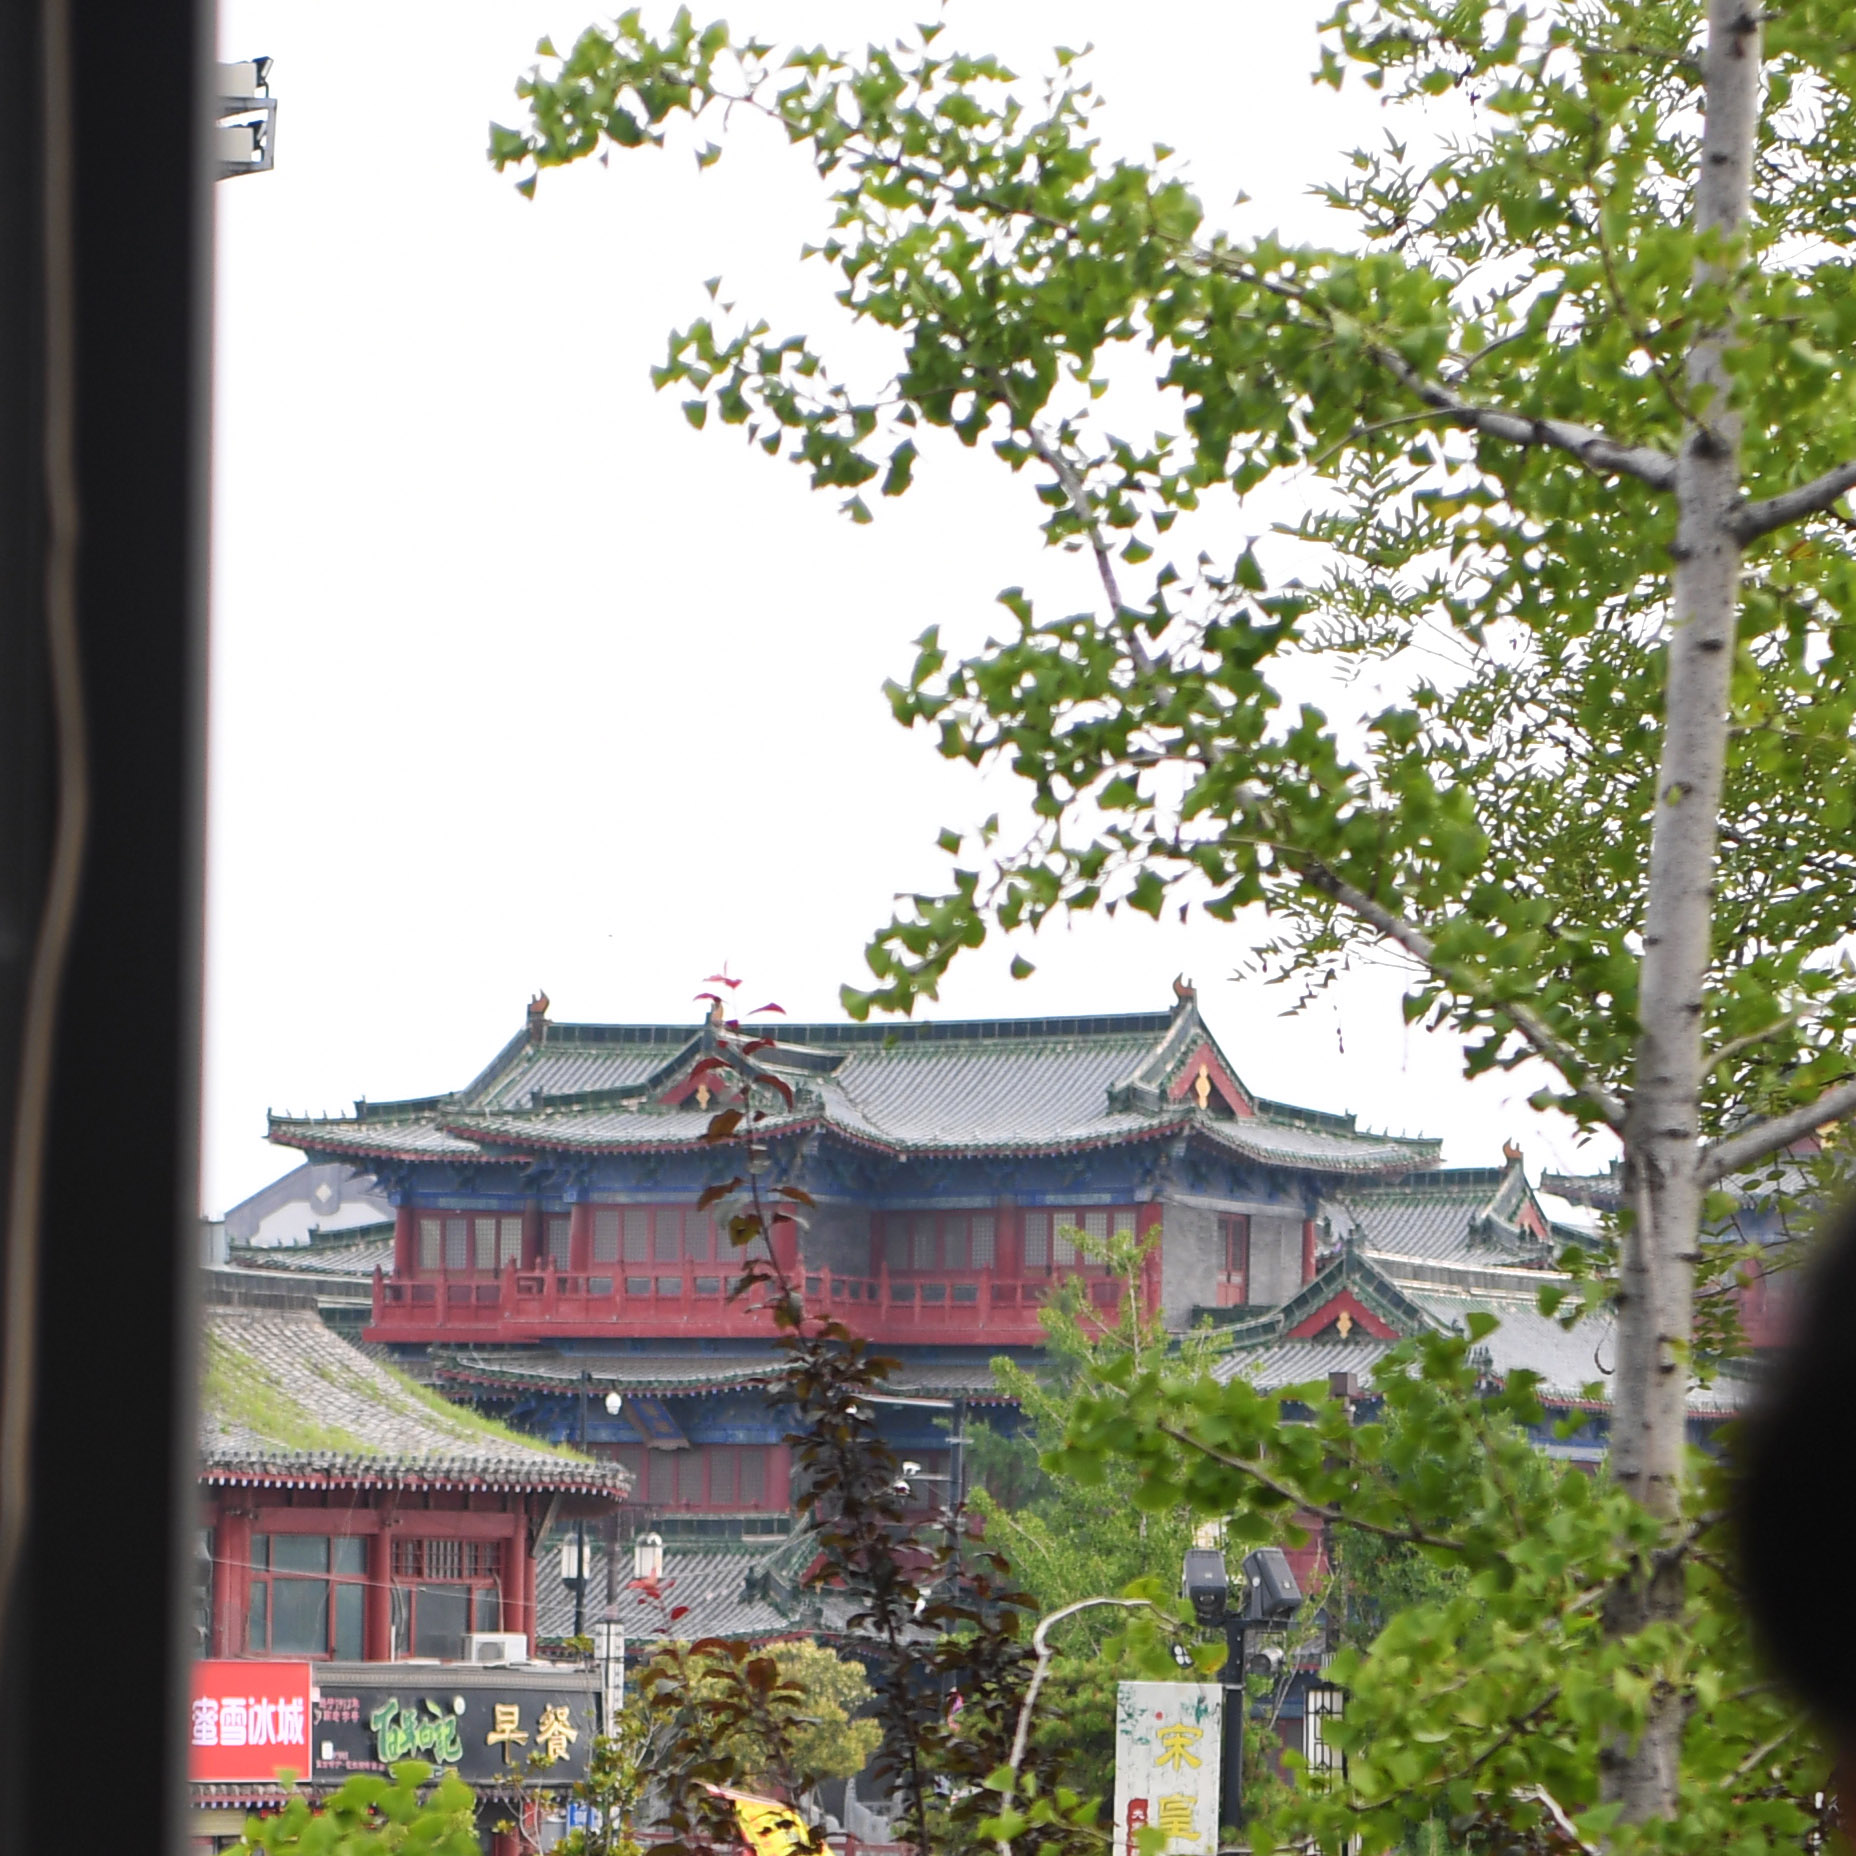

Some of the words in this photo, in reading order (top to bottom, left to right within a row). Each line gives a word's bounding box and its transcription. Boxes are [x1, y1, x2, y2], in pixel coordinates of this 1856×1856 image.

[191, 1696, 304, 1746] 蜜雪冰城
[486, 1702, 578, 1765] 早餐
